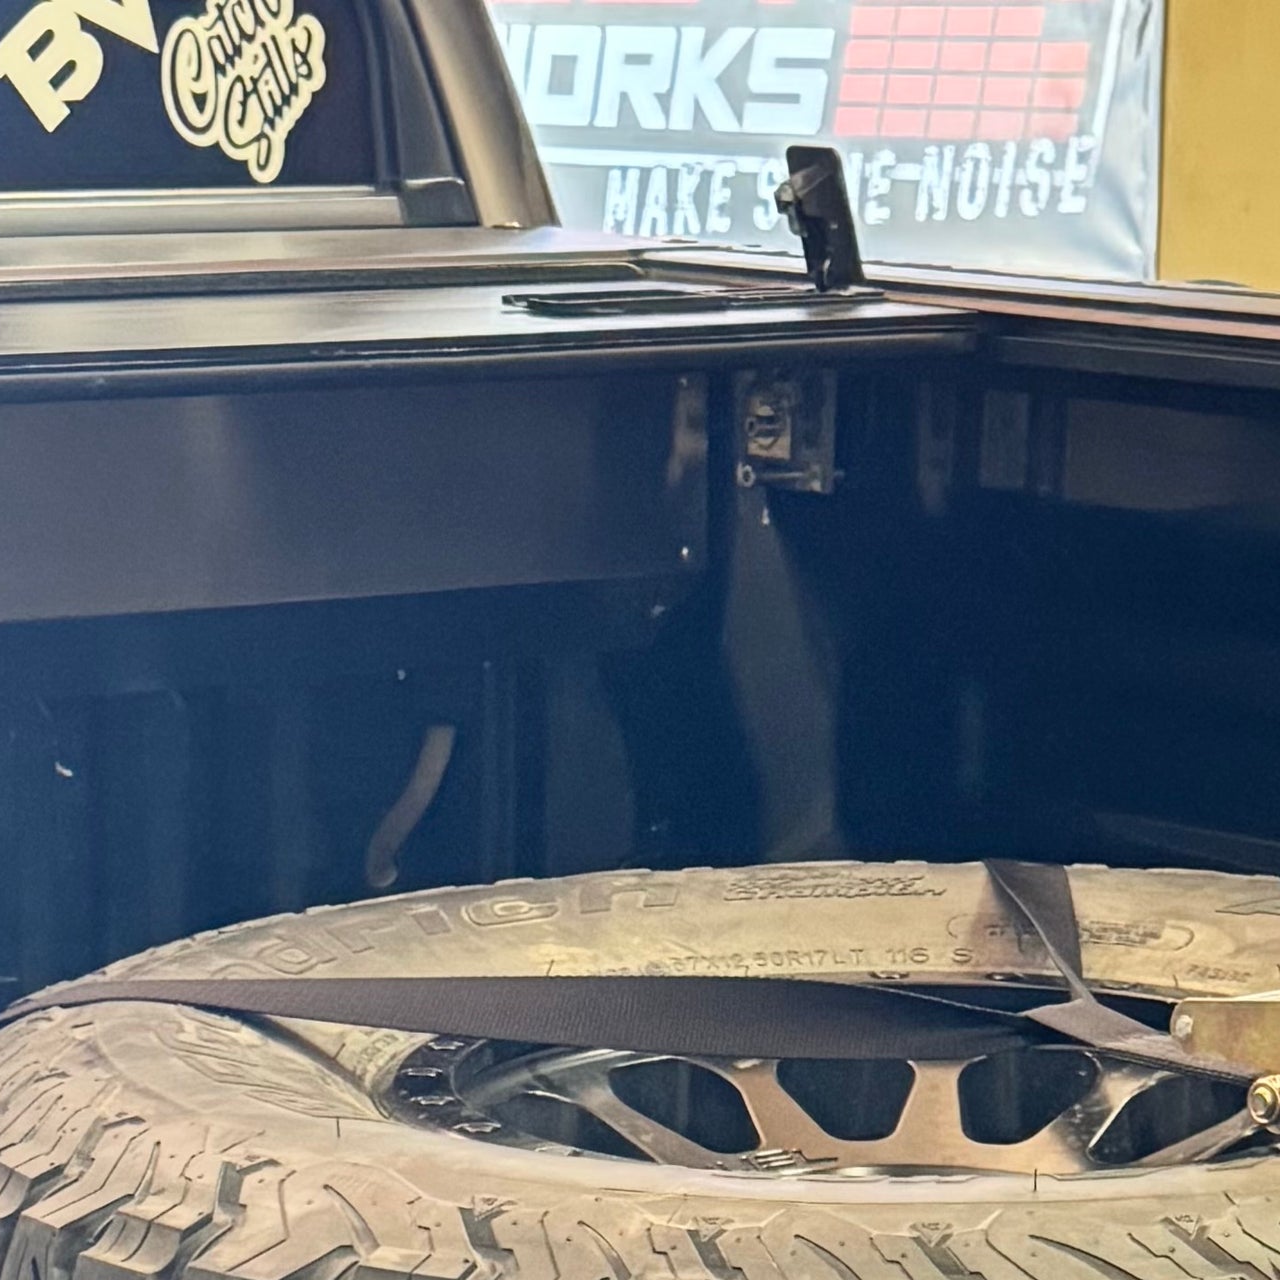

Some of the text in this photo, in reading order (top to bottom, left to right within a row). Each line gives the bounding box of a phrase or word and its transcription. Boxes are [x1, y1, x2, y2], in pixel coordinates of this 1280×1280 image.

[604, 133, 1098, 238] MAKE SE NOISE
